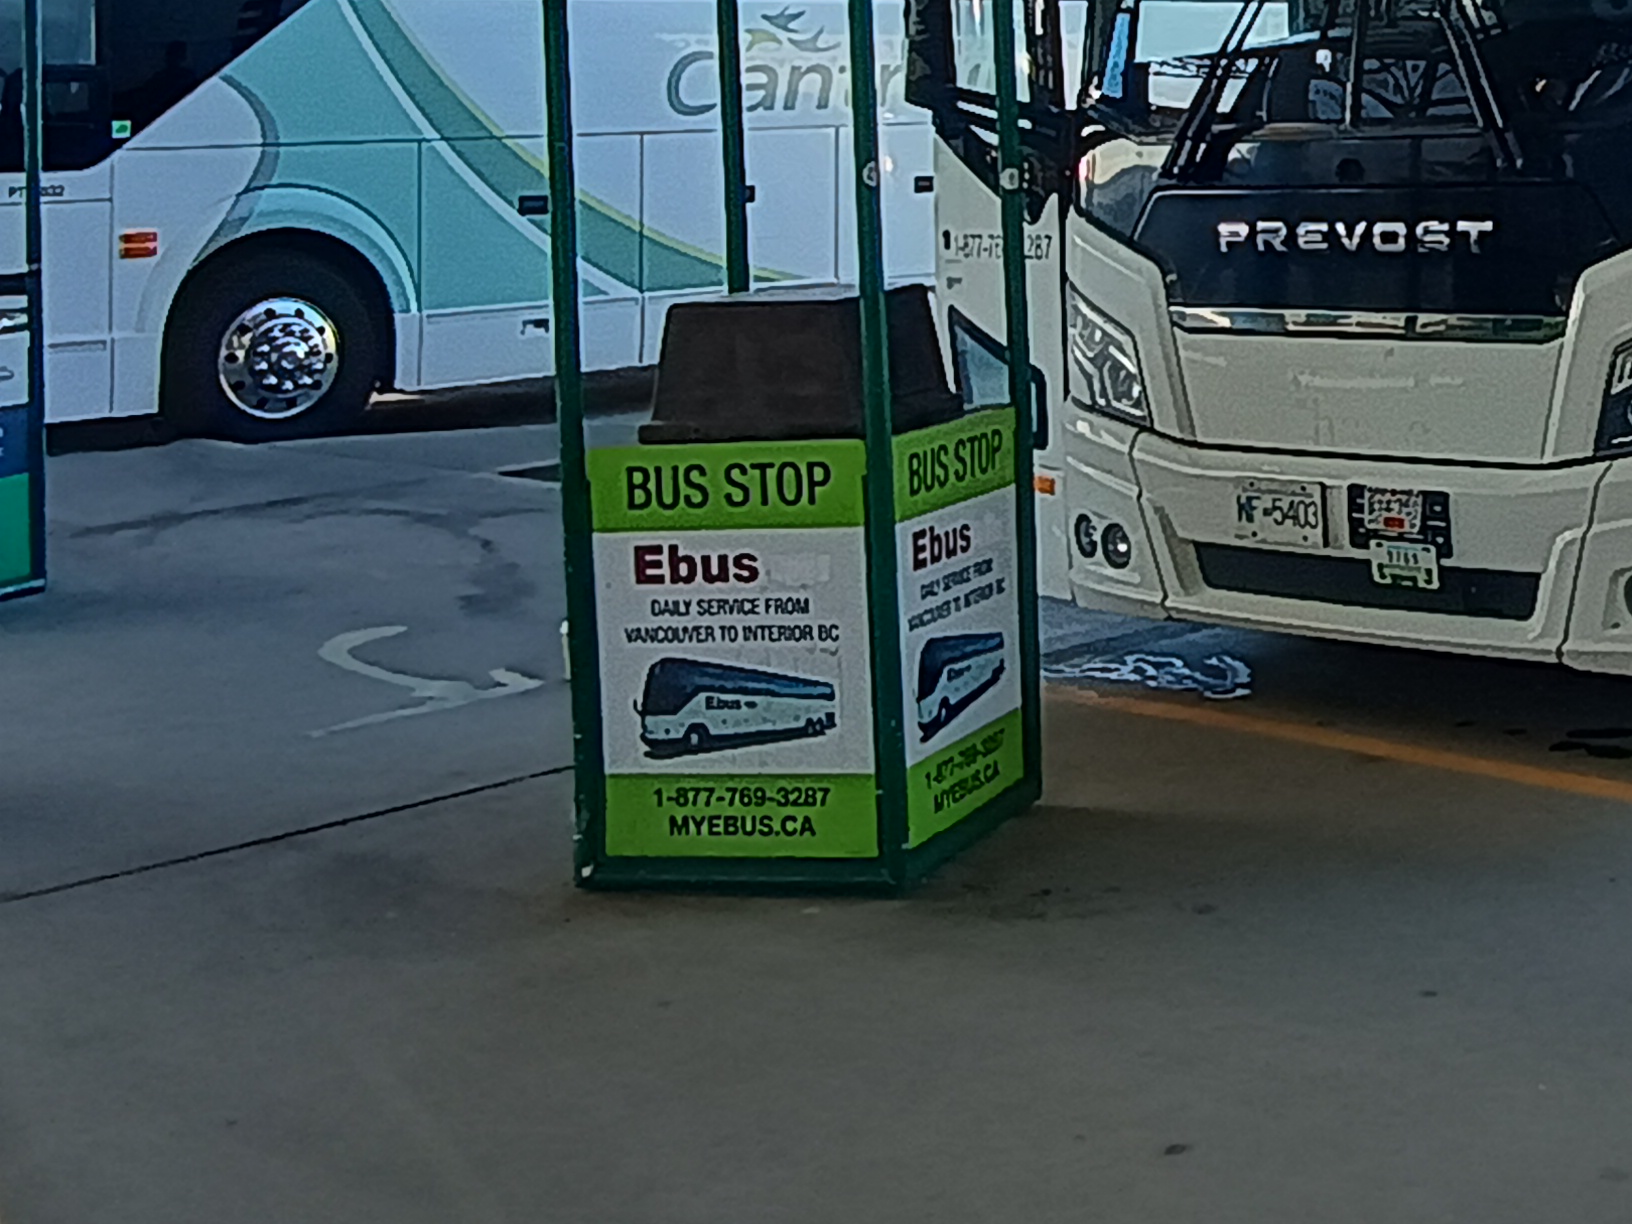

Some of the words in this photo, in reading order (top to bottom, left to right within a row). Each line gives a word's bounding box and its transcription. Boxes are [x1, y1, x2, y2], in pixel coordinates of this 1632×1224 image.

[1216, 220, 1494, 253] PREVOST
[908, 444, 949, 497] BUS
[953, 429, 1003, 482] STOP
[626, 463, 709, 511] BUS
[723, 461, 831, 508] STOP
[912, 524, 971, 571] Ebus
[633, 544, 760, 585] Ebus
[651, 598, 692, 616] DAILY
[696, 598, 760, 615] SERVICE
[764, 597, 810, 614] FROM
[624, 625, 715, 643] VANCOUVER
[718, 625, 739, 642] TO
[743, 624, 814, 641] INTERIOR
[818, 624, 840, 642] BC
[653, 787, 831, 807] 1-877-769-3287
[669, 815, 816, 837] MYEBUS.CA
